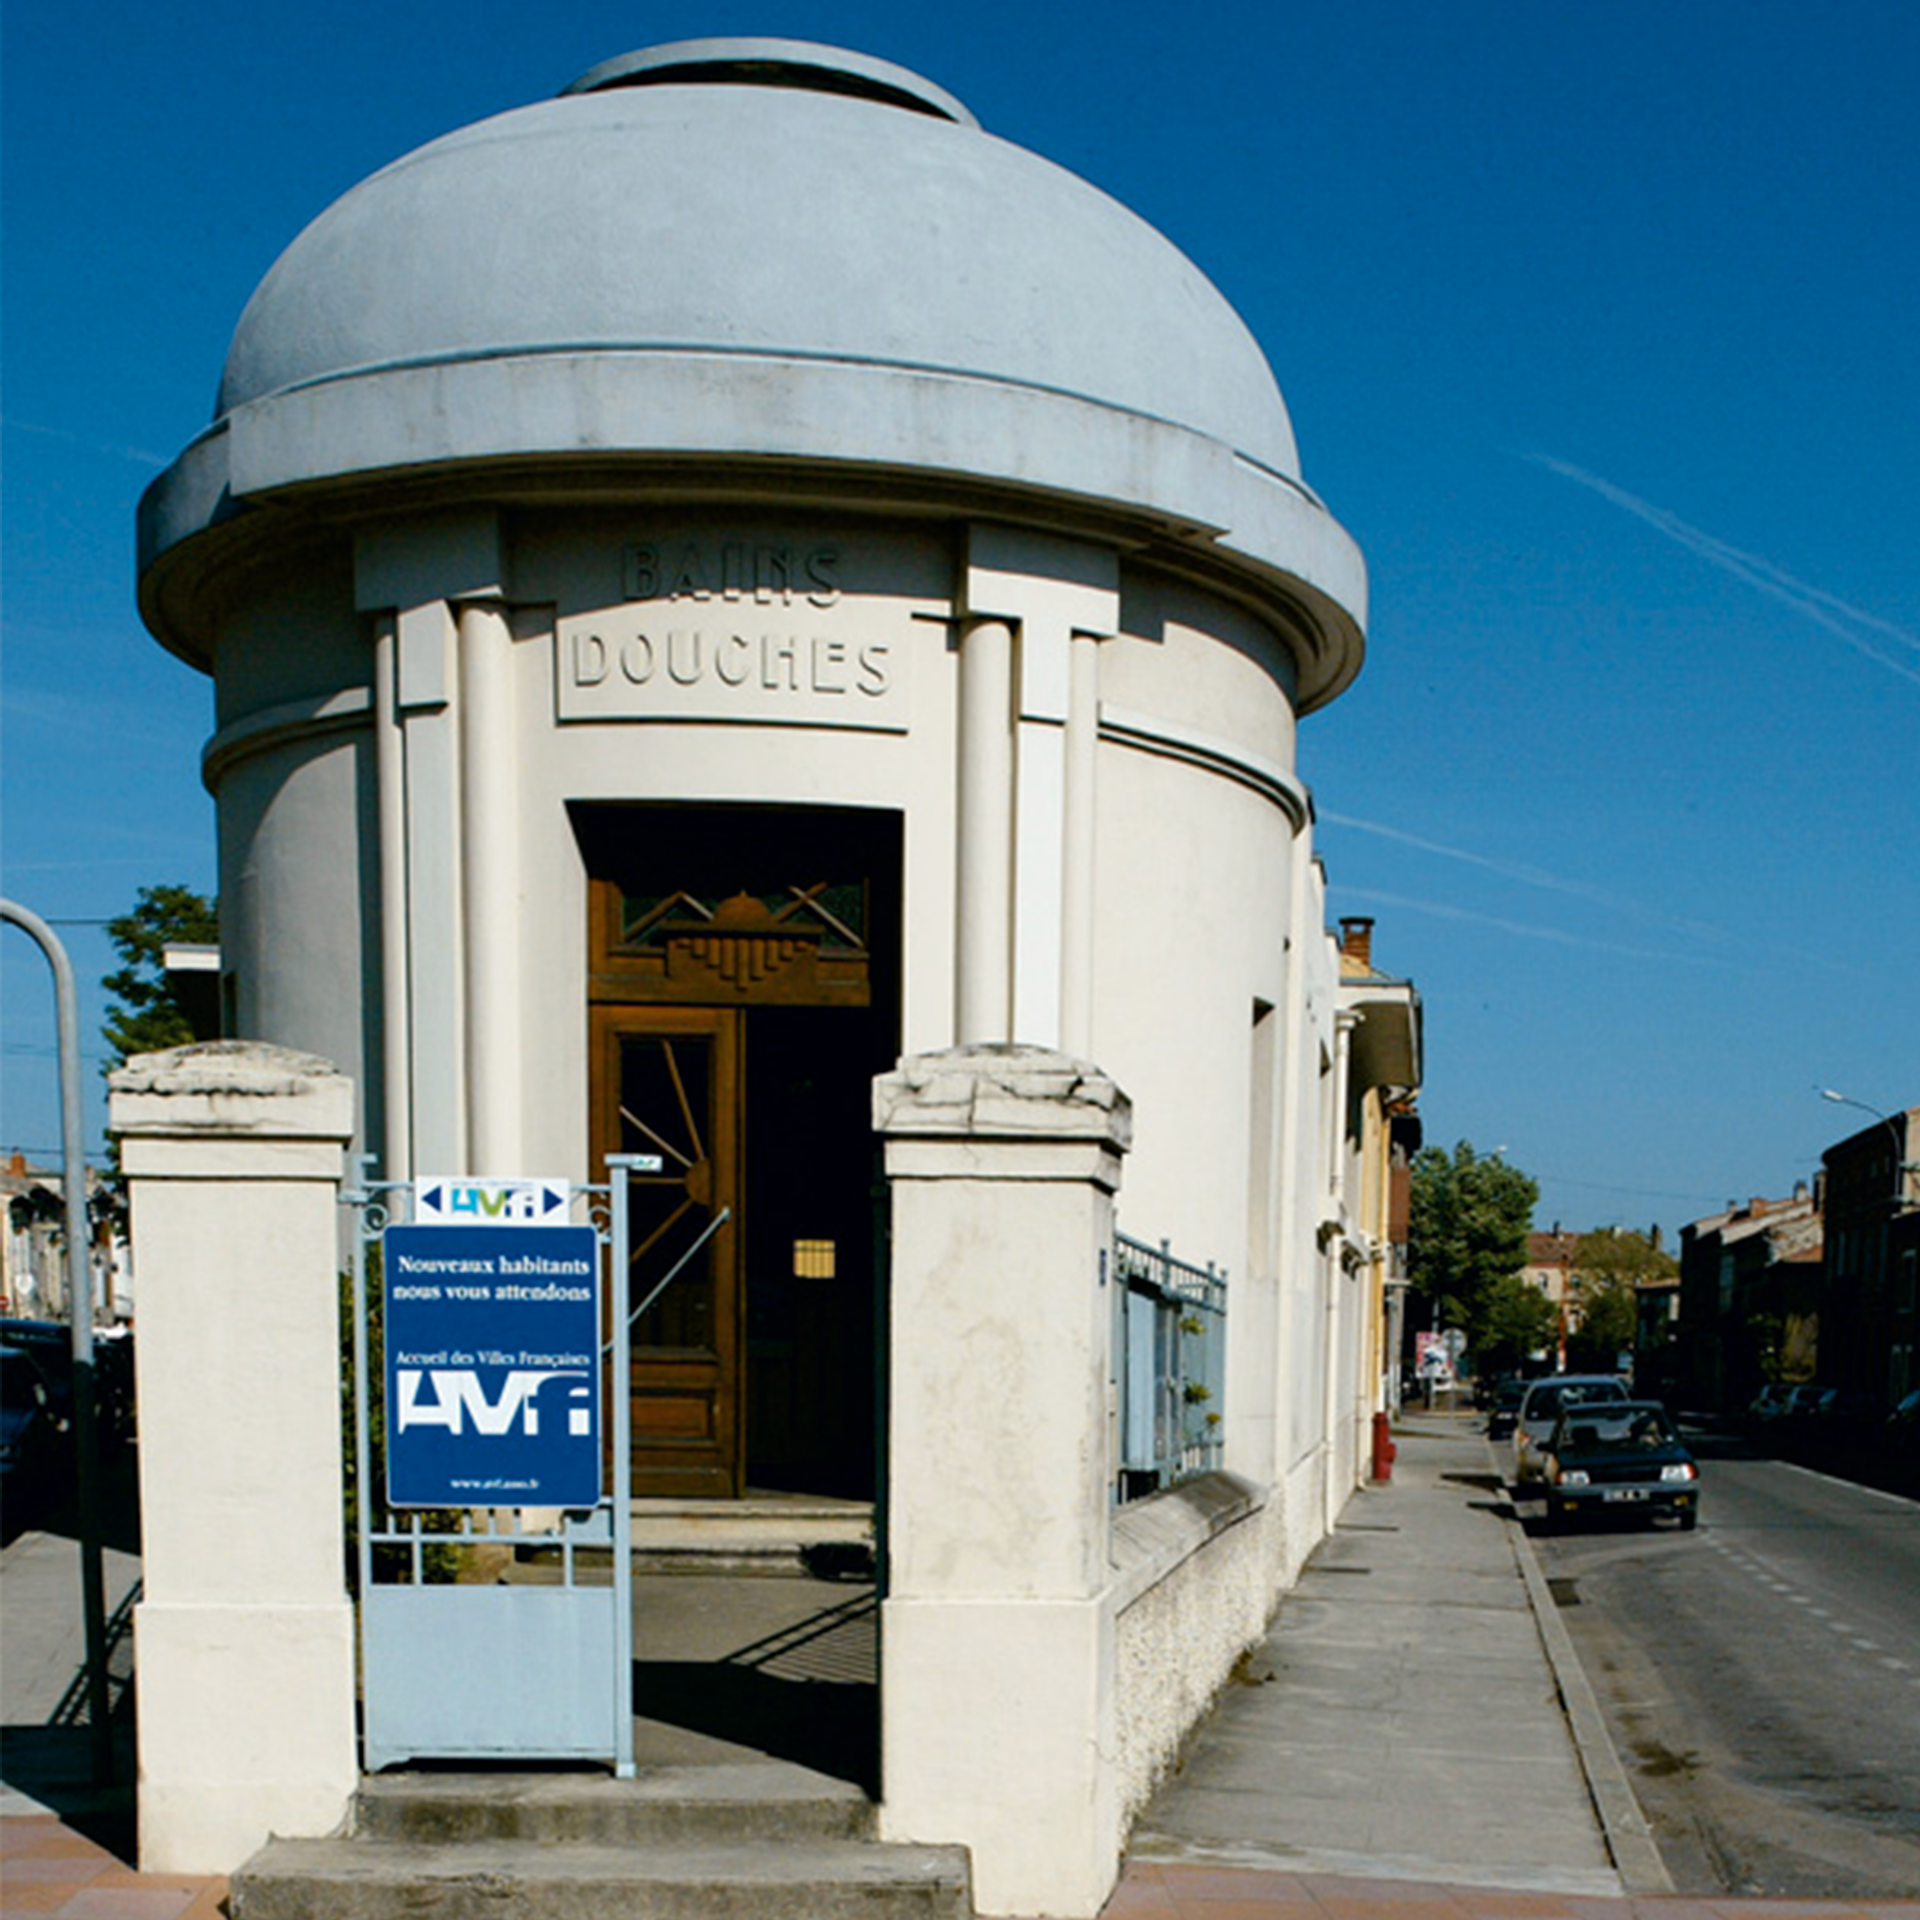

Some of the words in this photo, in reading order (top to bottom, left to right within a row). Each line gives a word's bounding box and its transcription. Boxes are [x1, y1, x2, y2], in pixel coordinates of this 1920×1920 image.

[622, 542, 841, 608] BAINS
[572, 631, 892, 696] DOUCHES
[398, 1255, 495, 1274] Nouveaux
[499, 1255, 591, 1275] habitants
[393, 1285, 442, 1301] nous
[445, 1285, 491, 1301] vous
[495, 1282, 592, 1301] attendons
[396, 1351, 447, 1365] Accueil
[451, 1351, 475, 1365] des
[477, 1351, 516, 1365] Villes
